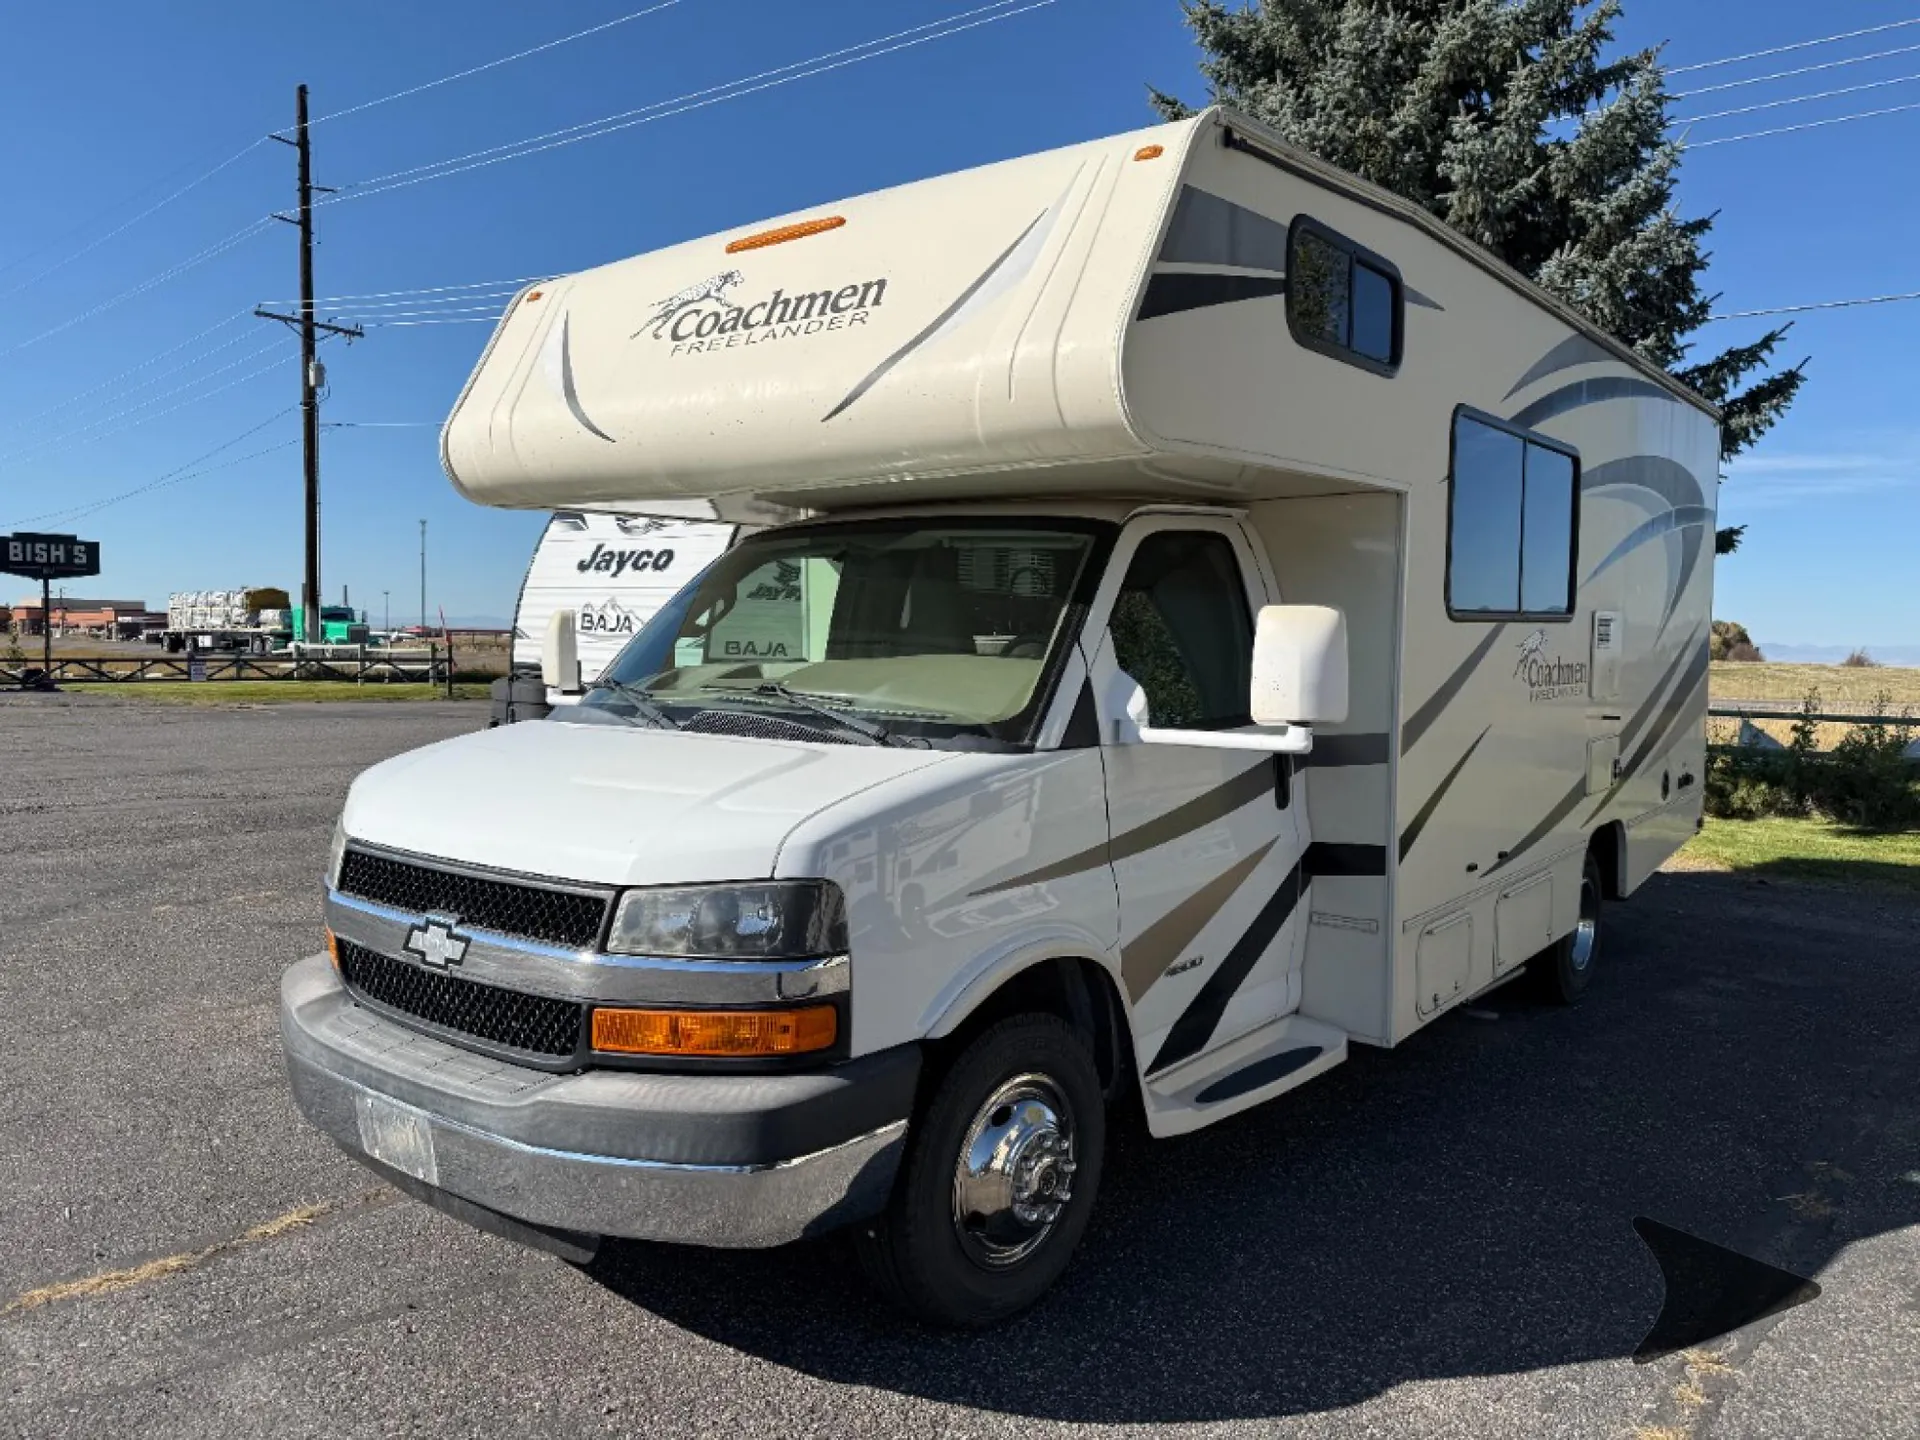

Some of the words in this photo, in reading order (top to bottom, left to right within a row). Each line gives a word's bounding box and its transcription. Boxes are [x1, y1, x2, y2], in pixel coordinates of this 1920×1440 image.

[671, 278, 887, 341] Coachmen
[670, 310, 869, 357] FREELANDER
[577, 543, 675, 577] Jayco
[580, 612, 633, 633] BAJA
[725, 641, 788, 657] BAJA
[1528, 657, 1586, 688] Coachmen
